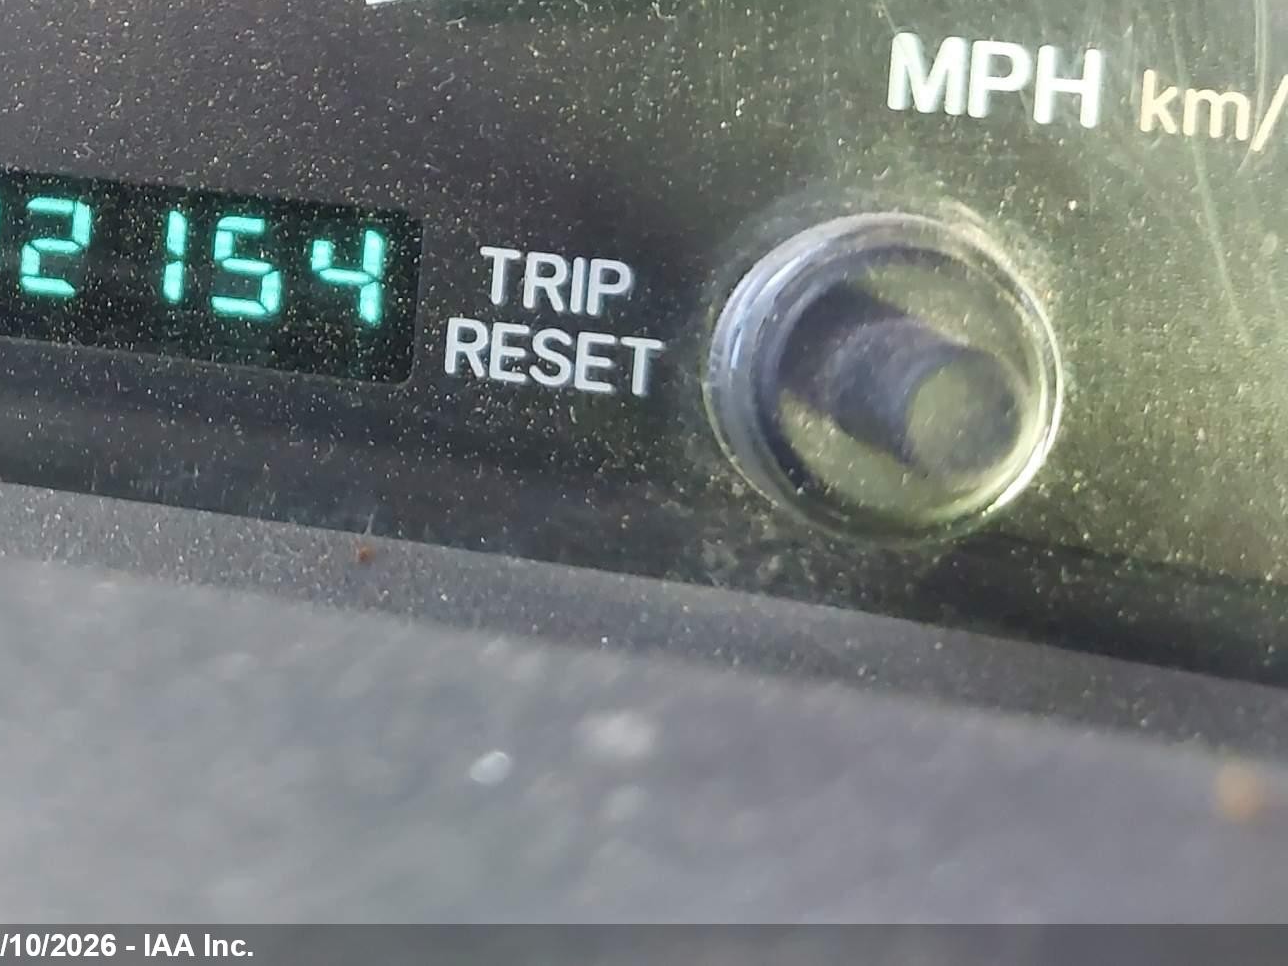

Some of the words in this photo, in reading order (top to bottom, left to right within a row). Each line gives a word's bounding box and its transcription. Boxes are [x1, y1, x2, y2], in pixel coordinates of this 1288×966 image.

[886, 31, 1103, 129] MPH
[1140, 68, 1288, 152] km/
[479, 245, 634, 316] TRIP
[444, 317, 663, 396] RESET
